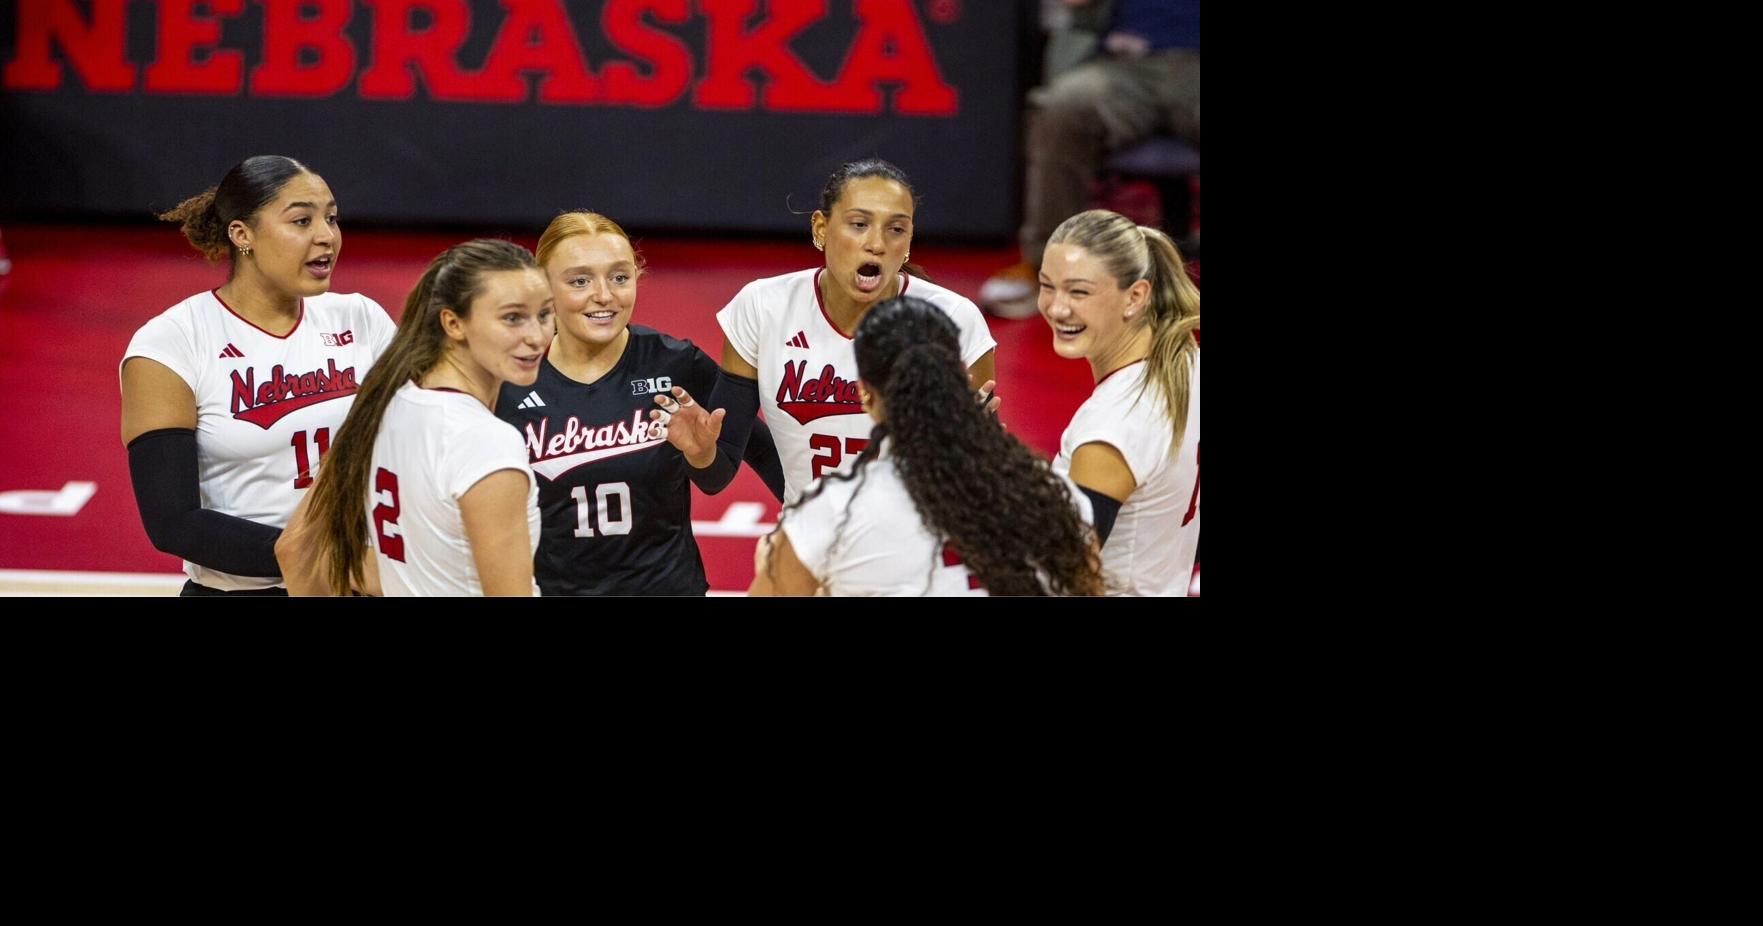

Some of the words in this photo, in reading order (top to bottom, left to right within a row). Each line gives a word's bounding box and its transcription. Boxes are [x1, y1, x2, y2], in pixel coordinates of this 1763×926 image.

[3, 0, 959, 117] NEBRASKA
[230, 358, 361, 414] Nebraska
[775, 359, 861, 404] Nebra
[372, 466, 407, 564] 2
[570, 480, 633, 538] 10
